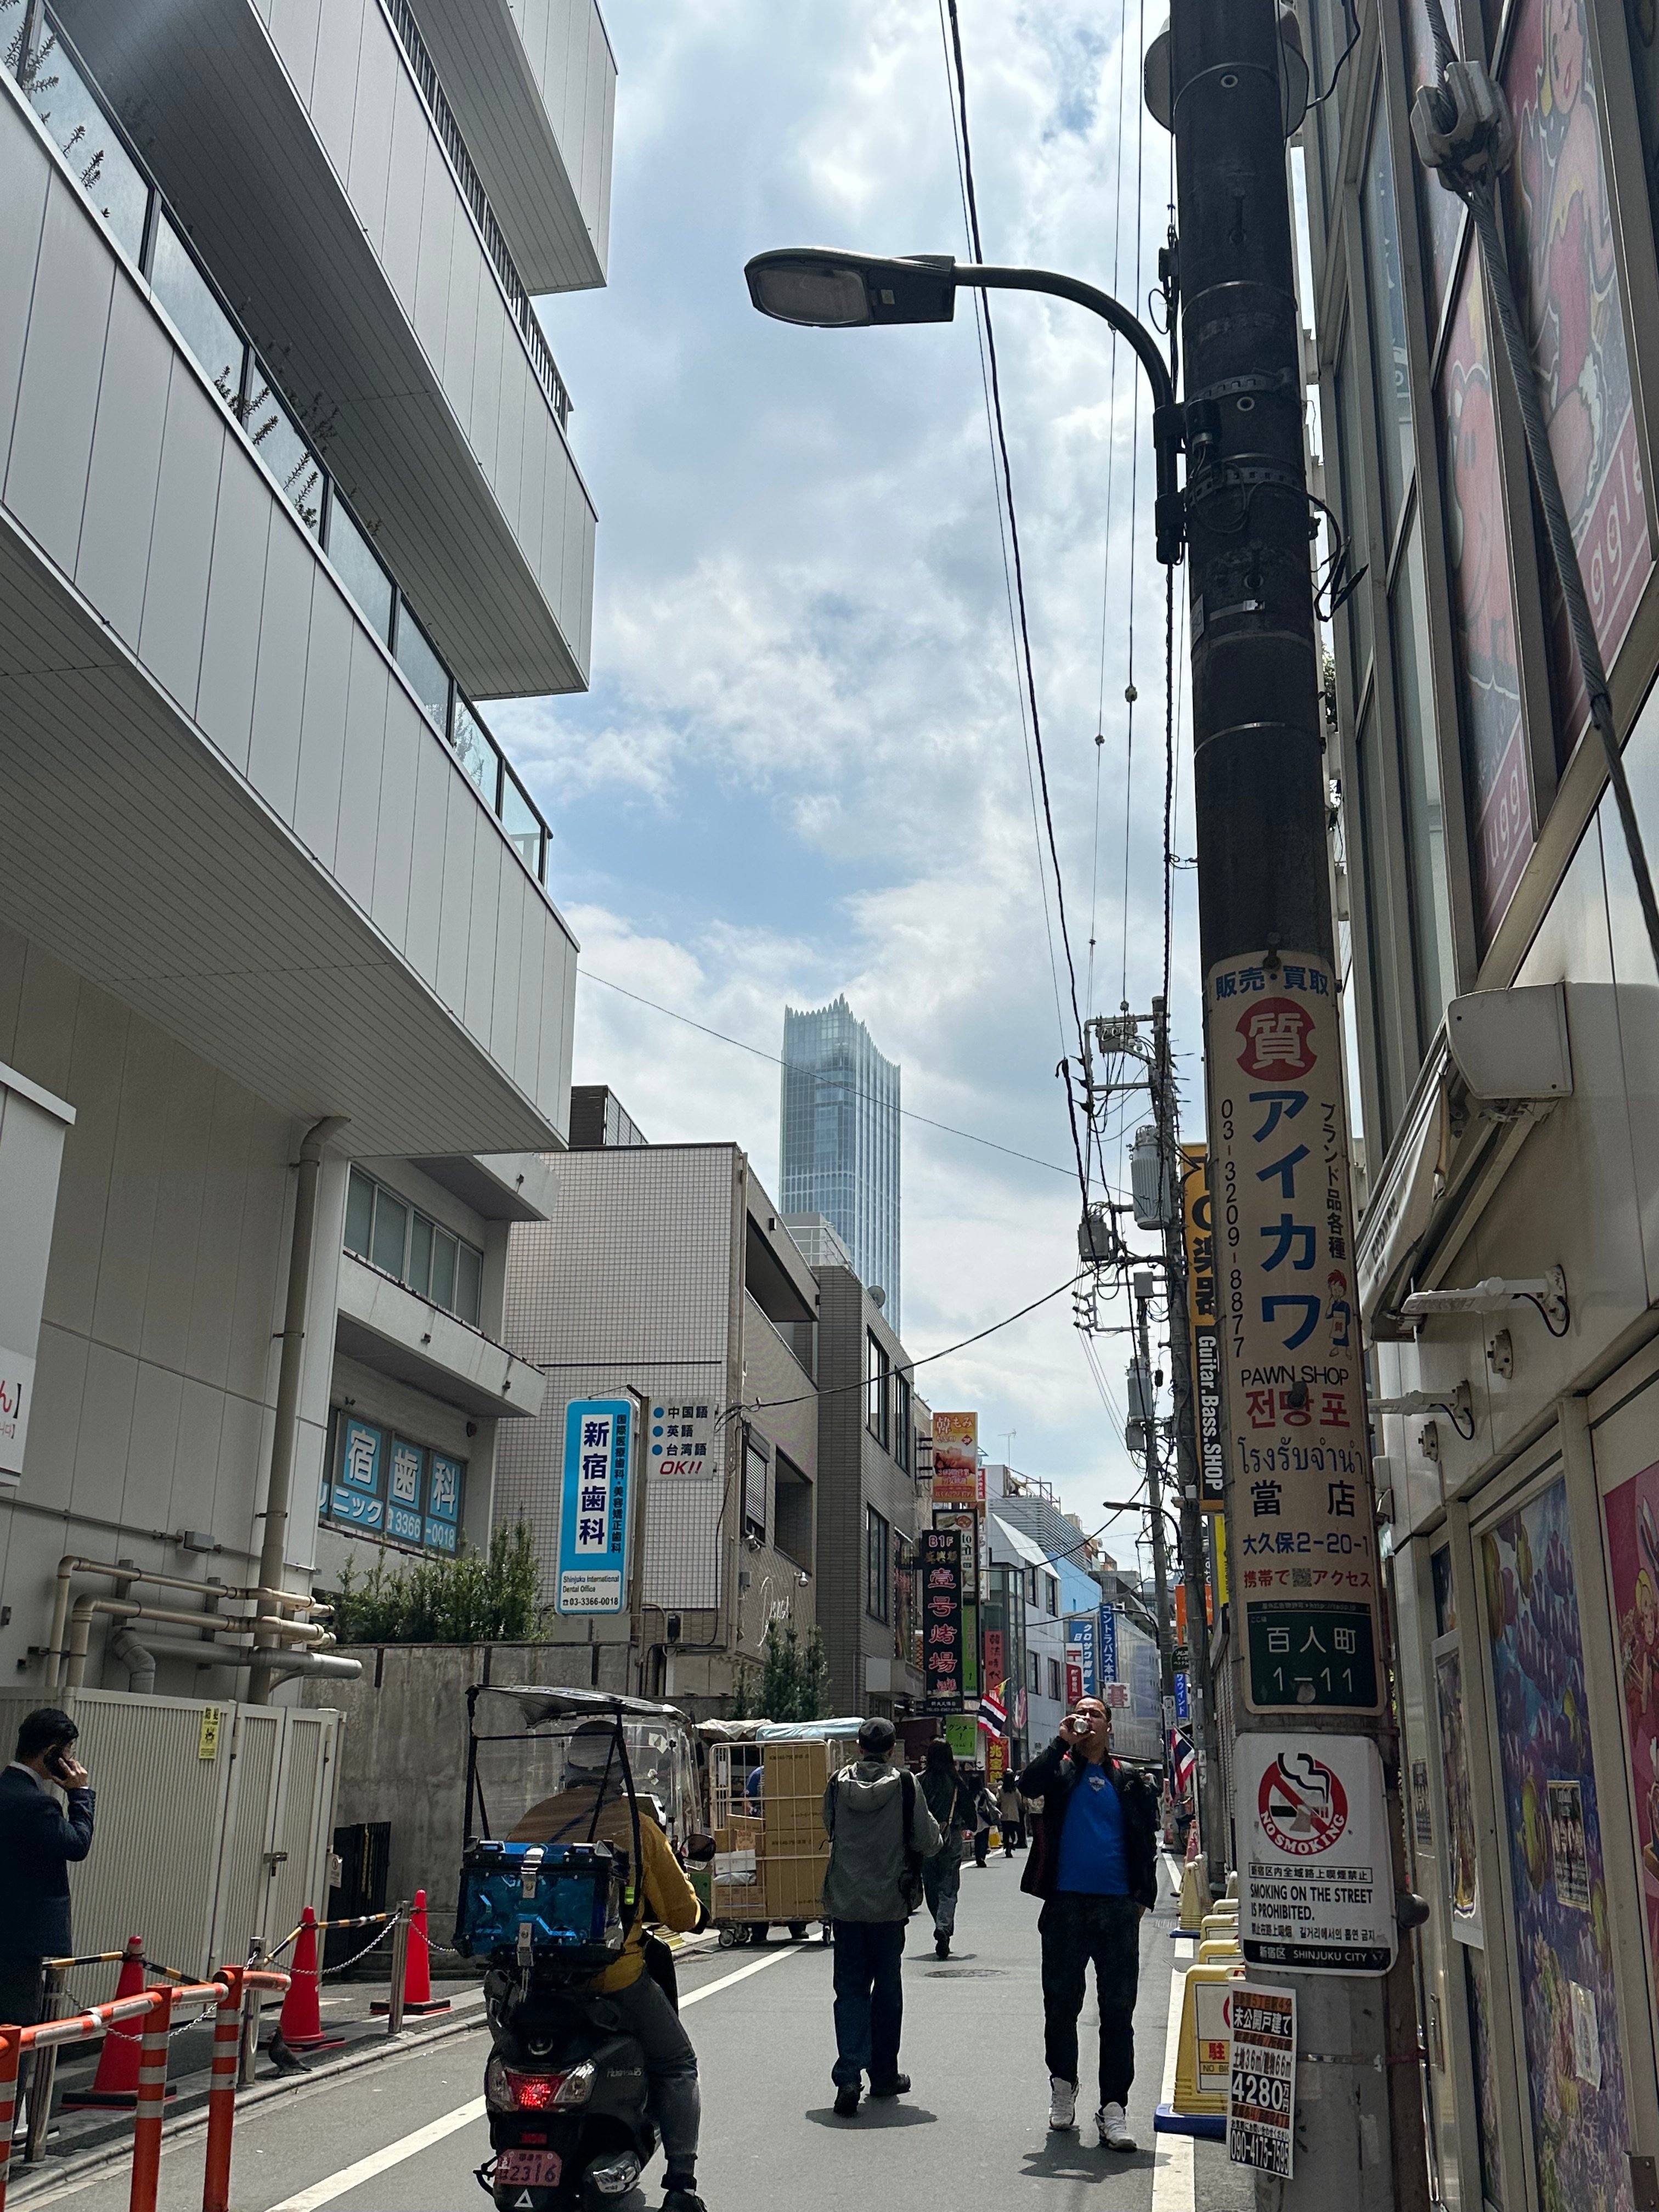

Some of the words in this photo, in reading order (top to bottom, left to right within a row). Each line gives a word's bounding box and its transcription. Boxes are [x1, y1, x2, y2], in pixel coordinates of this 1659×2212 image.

[1216, 965, 1328, 1000] 販売・買取
[1249, 1013, 1306, 1069] 質
[1321, 1102, 1347, 1261] ブランド品各種
[1221, 1099, 1244, 1358] 03-3209-8877
[1249, 1090, 1321, 1351] アイカワ
[1241, 1365, 1295, 1387] PAWN
[1300, 1365, 1349, 1386] SHOP
[668, 1406, 708, 1419] 中国語
[667, 1425, 693, 1437] 英語
[666, 1443, 707, 1457] 台湾語
[659, 1460, 702, 1475] OK!!
[579, 1421, 610, 1545] 新宿歯科
[928, 1535, 953, 1548] B1F
[1244, 1569, 1290, 1589] 携帯で
[1102, 1605, 1114, 1683] コントラバス本店
[1266, 1626, 1356, 1654] 百人町
[1260, 1810, 1276, 1836] NO
[1274, 1813, 1345, 1854] SMOKING
[1251, 1866, 1368, 1881] 新宿区内全域路上喫煙禁止
[1250, 1883, 1287, 1900] SMOKING
[1290, 1886, 1307, 1901] ON
[1310, 1886, 1331, 1903] THE
[1334, 1887, 1373, 1904] STREET
[1251, 1901, 1257, 1917] IS
[1259, 1903, 1315, 1921] PROHIBITED.
[1260, 1945, 1286, 1960] 新宿区
[1293, 1950, 1342, 1962] SHINJUKU
[1345, 1952, 1367, 1962] CITY
[1234, 2006, 1291, 2035] 未公開戸建て
